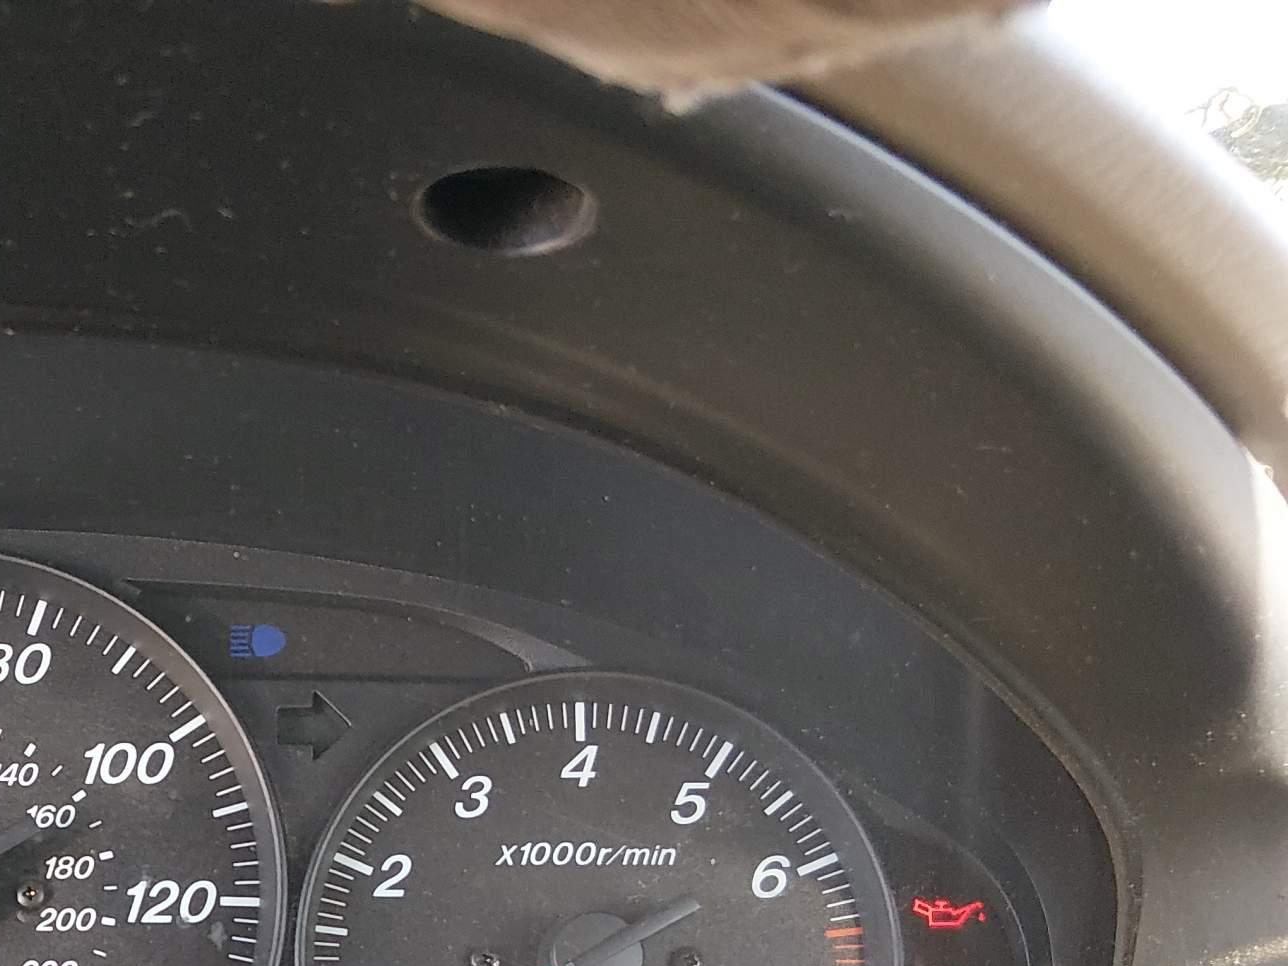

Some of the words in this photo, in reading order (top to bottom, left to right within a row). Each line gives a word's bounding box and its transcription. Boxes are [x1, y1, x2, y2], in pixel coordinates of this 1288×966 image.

[85, 743, 174, 784] 100
[561, 745, 598, 787] 4
[455, 776, 492, 818] 3
[671, 783, 710, 824] 5
[46, 856, 94, 879] 180
[373, 855, 411, 897] 2
[752, 856, 790, 898] 6
[36, 908, 96, 931] 200
[127, 880, 216, 923] 120
